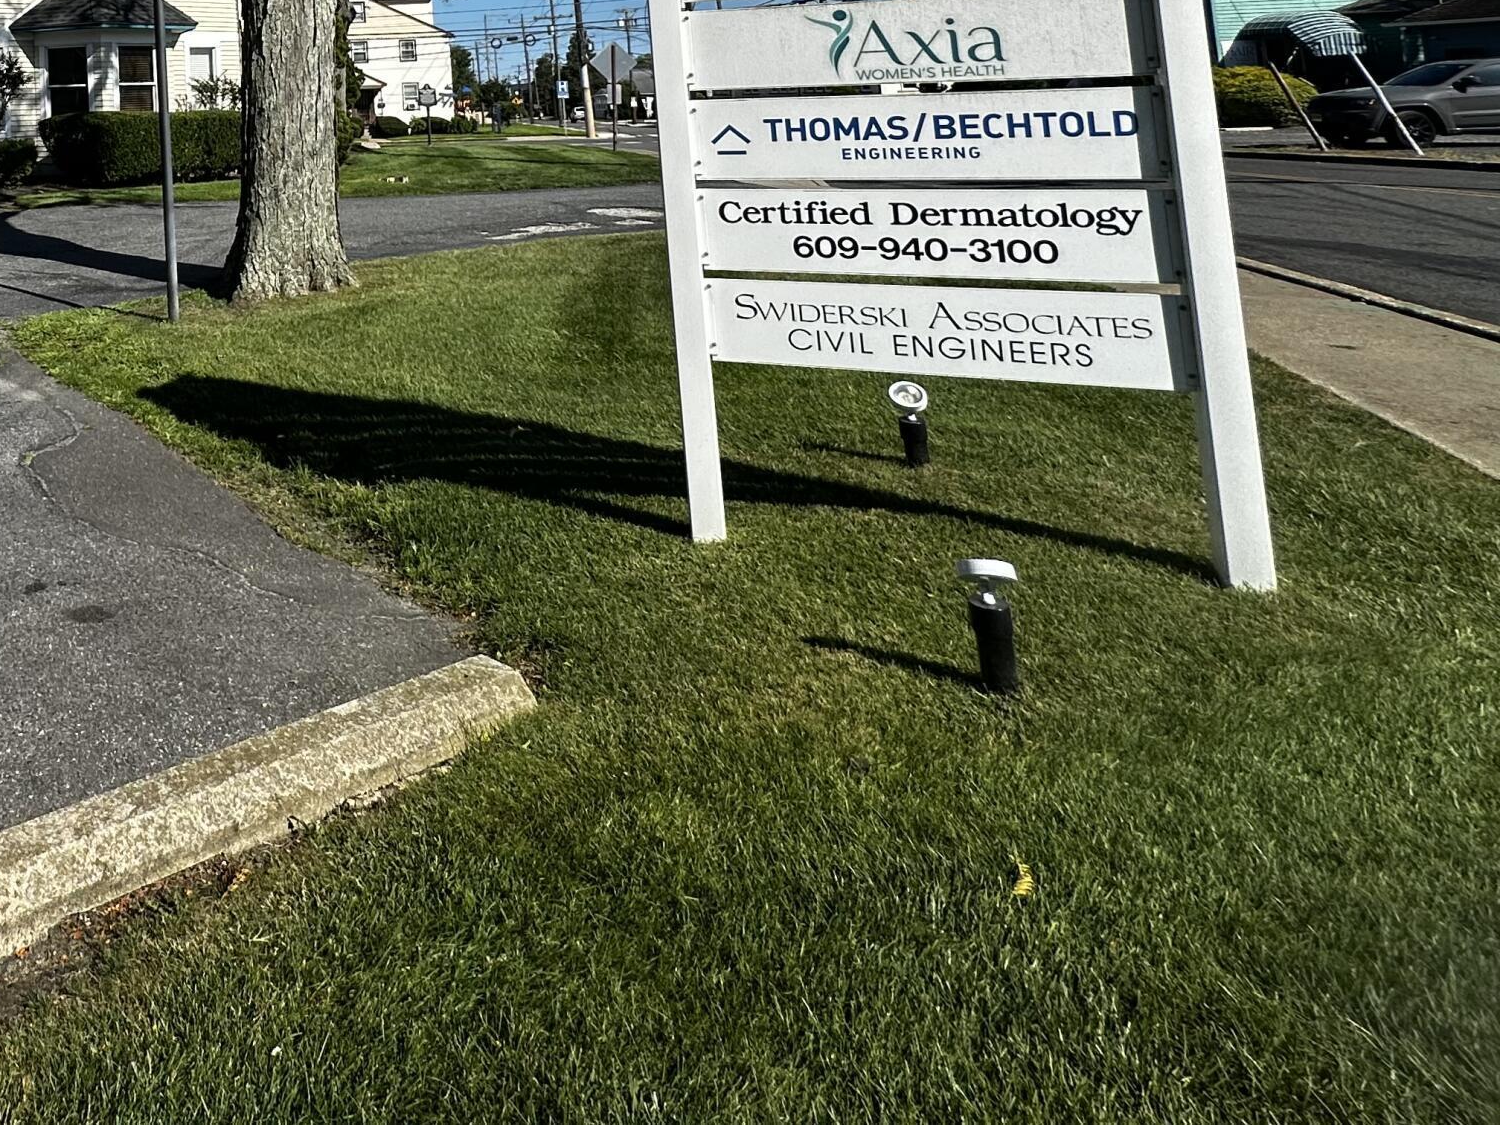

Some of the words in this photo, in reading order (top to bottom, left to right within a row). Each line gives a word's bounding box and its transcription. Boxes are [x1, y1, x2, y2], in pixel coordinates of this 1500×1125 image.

[852, 17, 1008, 67] Axia
[855, 65, 937, 81] WOMEN'S
[941, 63, 1005, 78] HEALTH
[763, 110, 1139, 143] THOMAS/BECHTOLD
[841, 147, 981, 160] ENGINEERING
[718, 200, 873, 227] Certified
[890, 201, 1143, 236] Dermatology
[793, 236, 1059, 264] 609-940-3100
[734, 293, 907, 329] SWIDERSKI
[929, 301, 1153, 340] ASSOCIATES
[787, 328, 874, 356] CIVIL
[893, 335, 1094, 368] ENGINEERS
